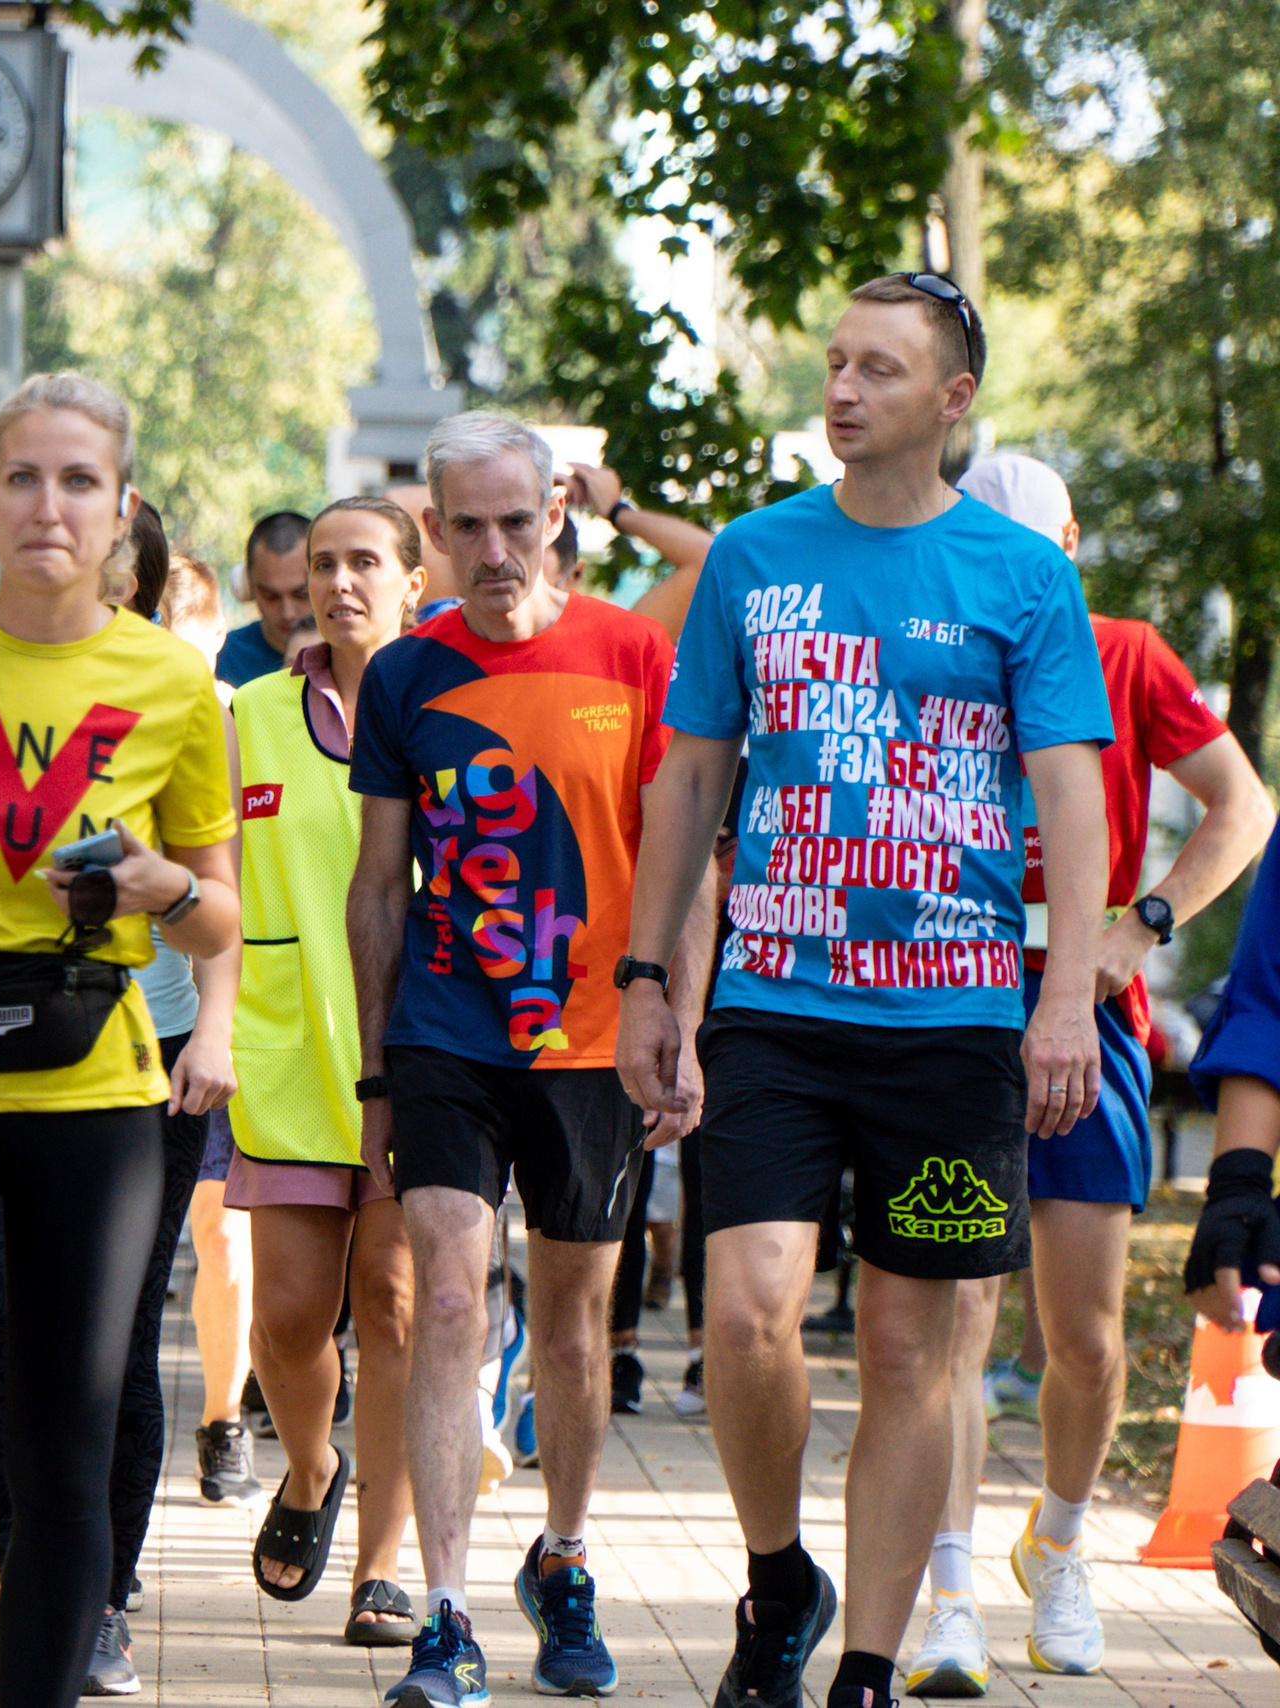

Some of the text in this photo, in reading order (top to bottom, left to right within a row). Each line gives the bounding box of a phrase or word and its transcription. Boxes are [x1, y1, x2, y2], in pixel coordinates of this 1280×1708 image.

[745, 583, 823, 637] 2024
[753, 631, 881, 686] #МЕЧТА
[571, 703, 629, 719] UGRESHA
[585, 718, 622, 733] TRAIL
[919, 694, 1011, 752] #ЦЕЛЬ
[747, 785, 831, 834] #ЗАБЕГ
[766, 836, 963, 894] #ГОРДОСТЬ
[427, 902, 453, 975] trail
[913, 893, 997, 939] 2024
[827, 939, 1020, 989] #ЕДИНСТВО
[888, 1213, 1006, 1242] Kappa
